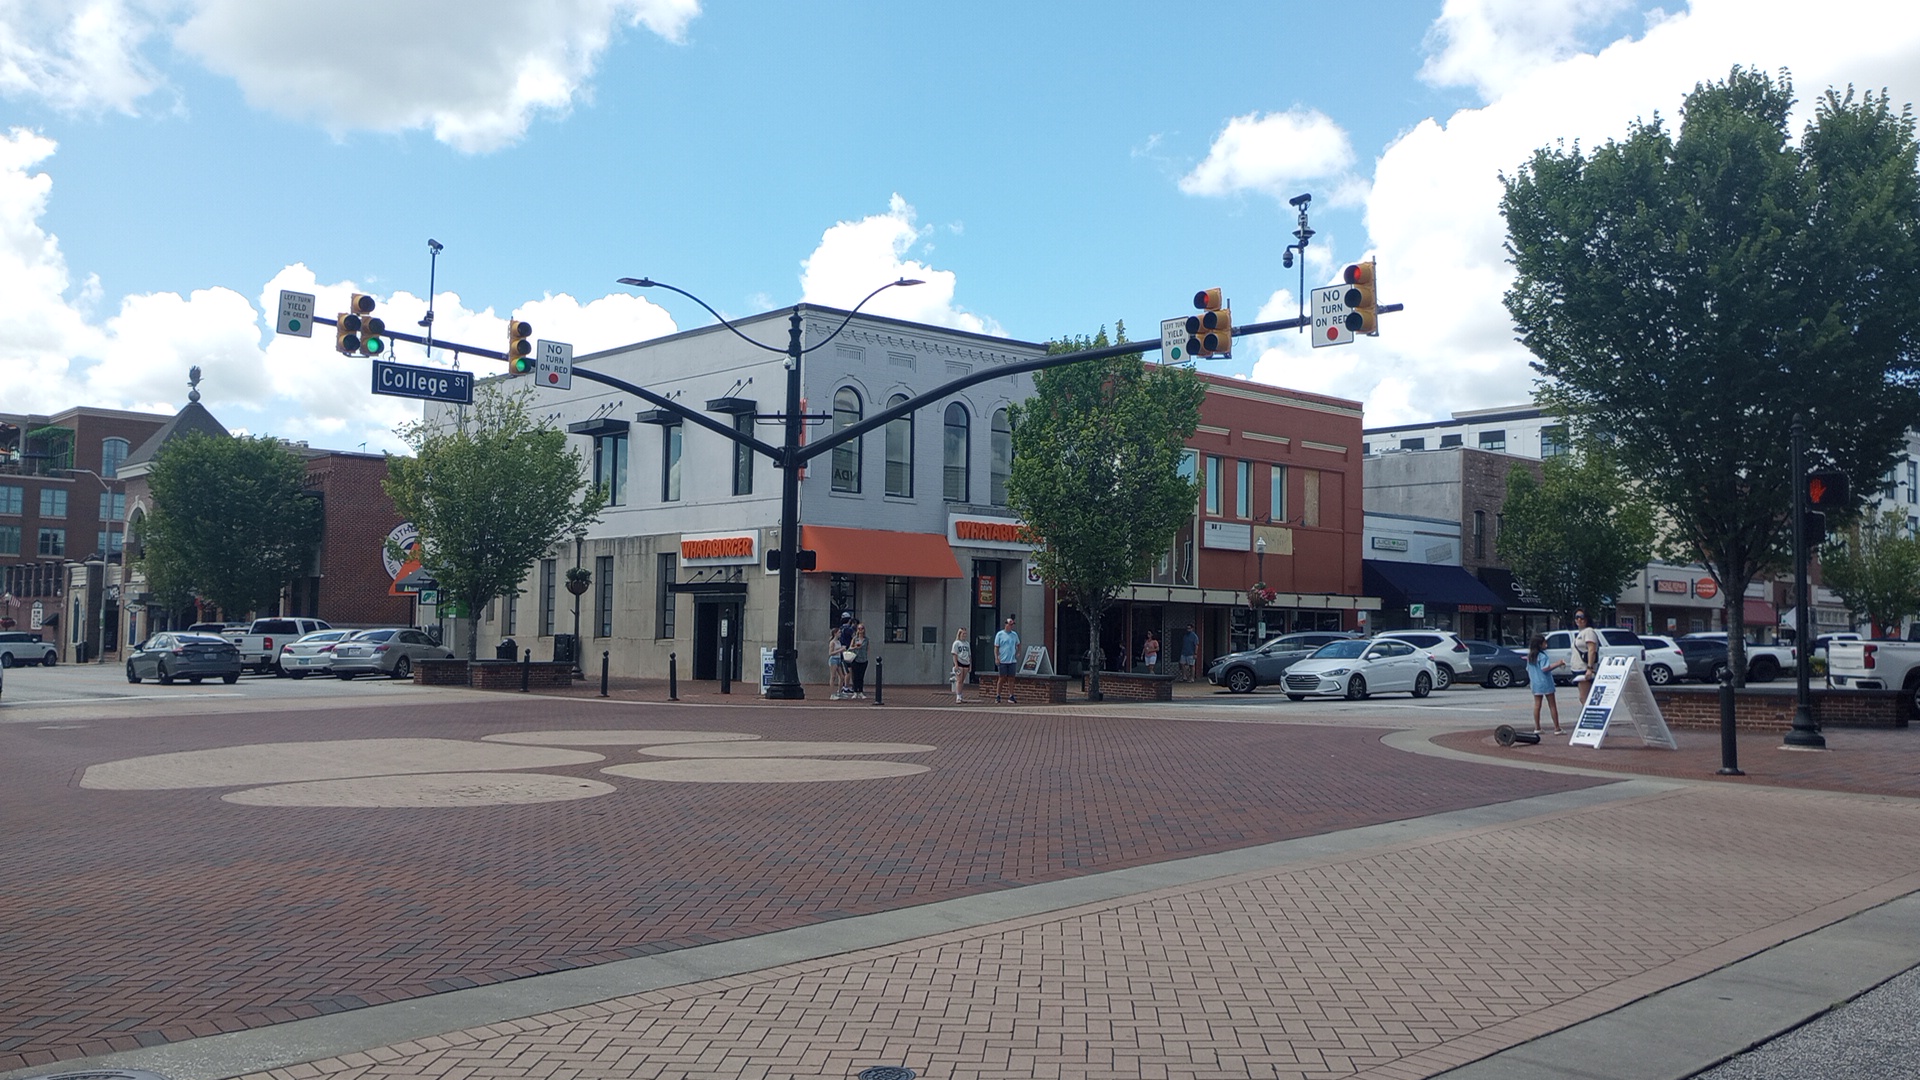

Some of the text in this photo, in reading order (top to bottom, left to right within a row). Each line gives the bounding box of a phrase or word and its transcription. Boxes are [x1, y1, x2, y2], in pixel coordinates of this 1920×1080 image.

[1323, 290, 1340, 303] NO
[288, 302, 306, 312] YIELD
[1321, 303, 1343, 315] TURN
[1316, 318, 1327, 327] ON
[1167, 329, 1183, 338] YIELD
[548, 344, 562, 354] NO
[546, 355, 564, 364] TURN
[554, 366, 568, 374] RED
[382, 368, 464, 396] College St
[681, 538, 753, 559] WHATABURGER
